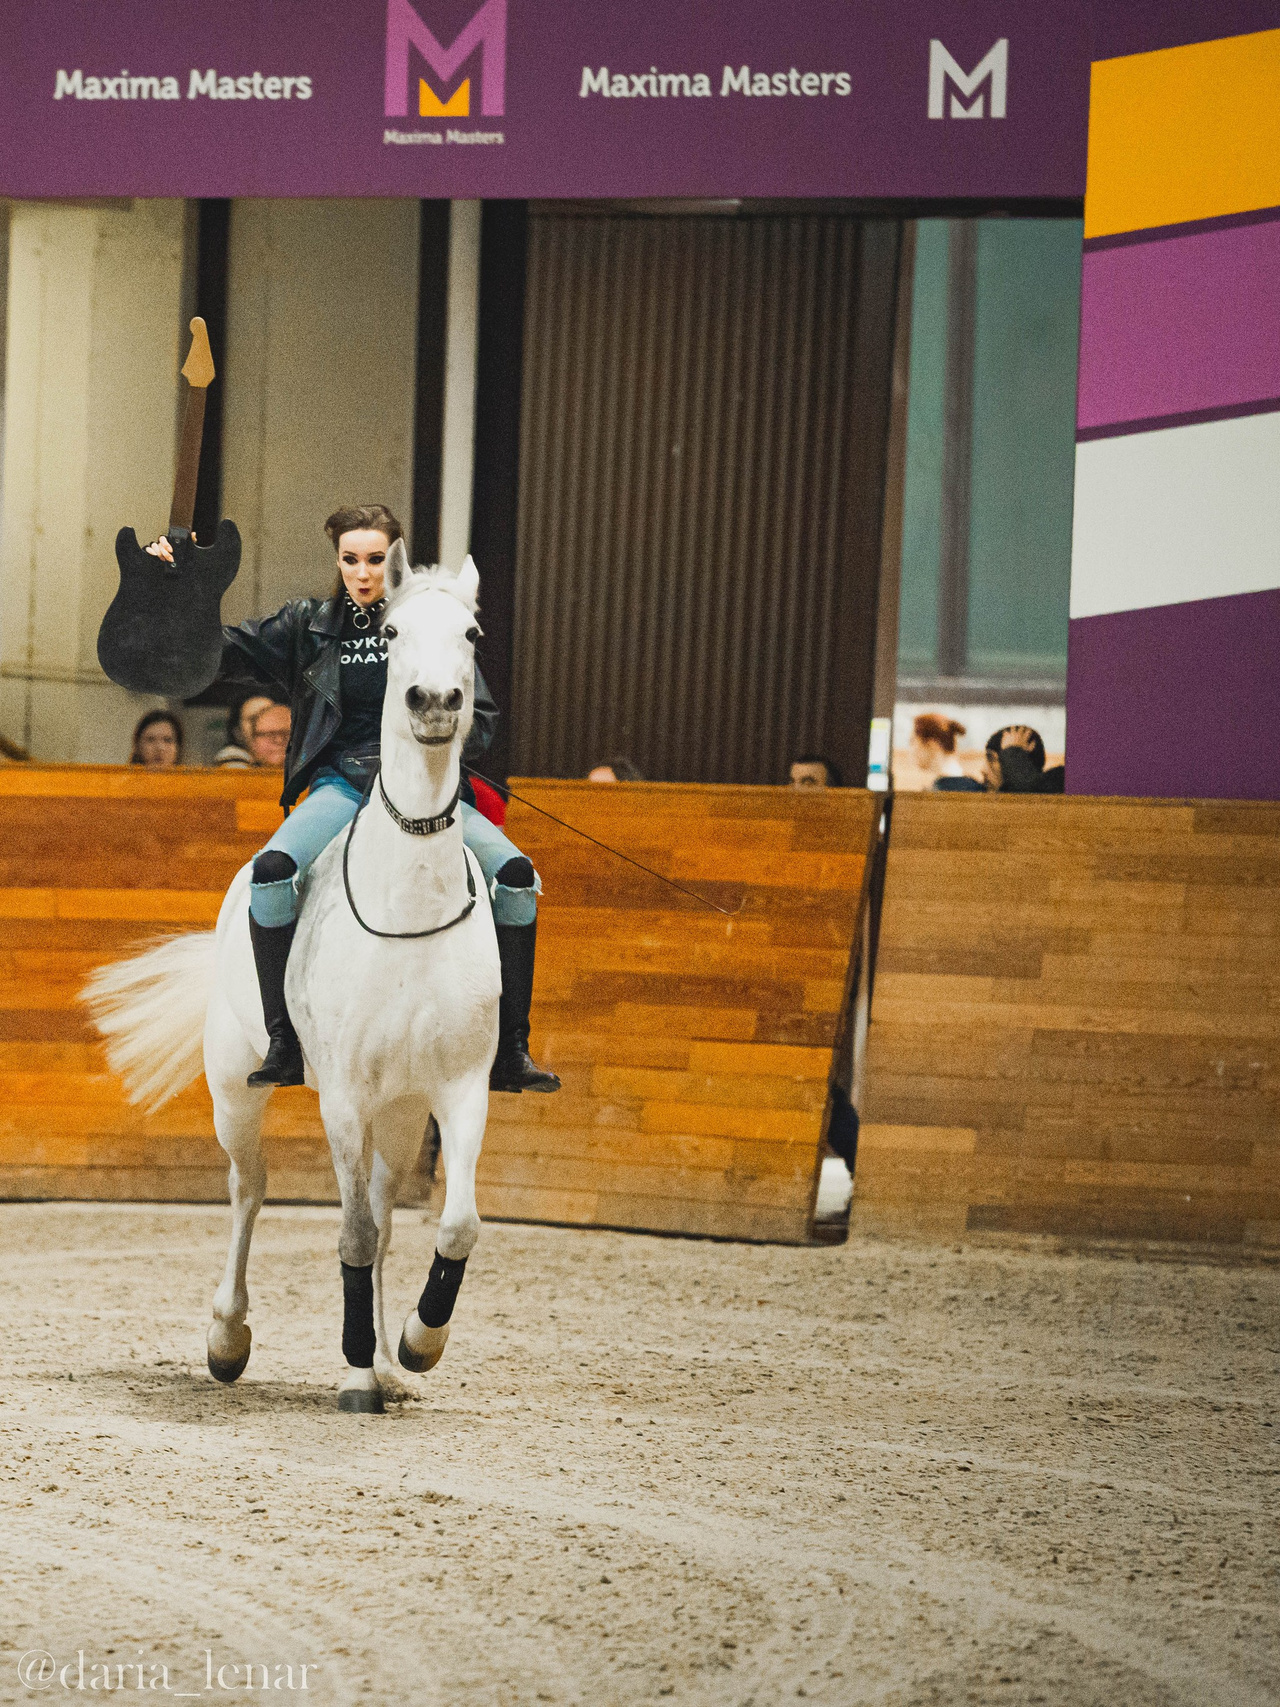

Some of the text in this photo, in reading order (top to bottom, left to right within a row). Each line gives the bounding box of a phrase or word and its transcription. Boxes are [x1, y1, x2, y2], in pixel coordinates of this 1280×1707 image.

[54, 68, 313, 101] Maxima Masters
[579, 65, 852, 98] Maxima Masters
[383, 128, 505, 145] Maxima Masters
